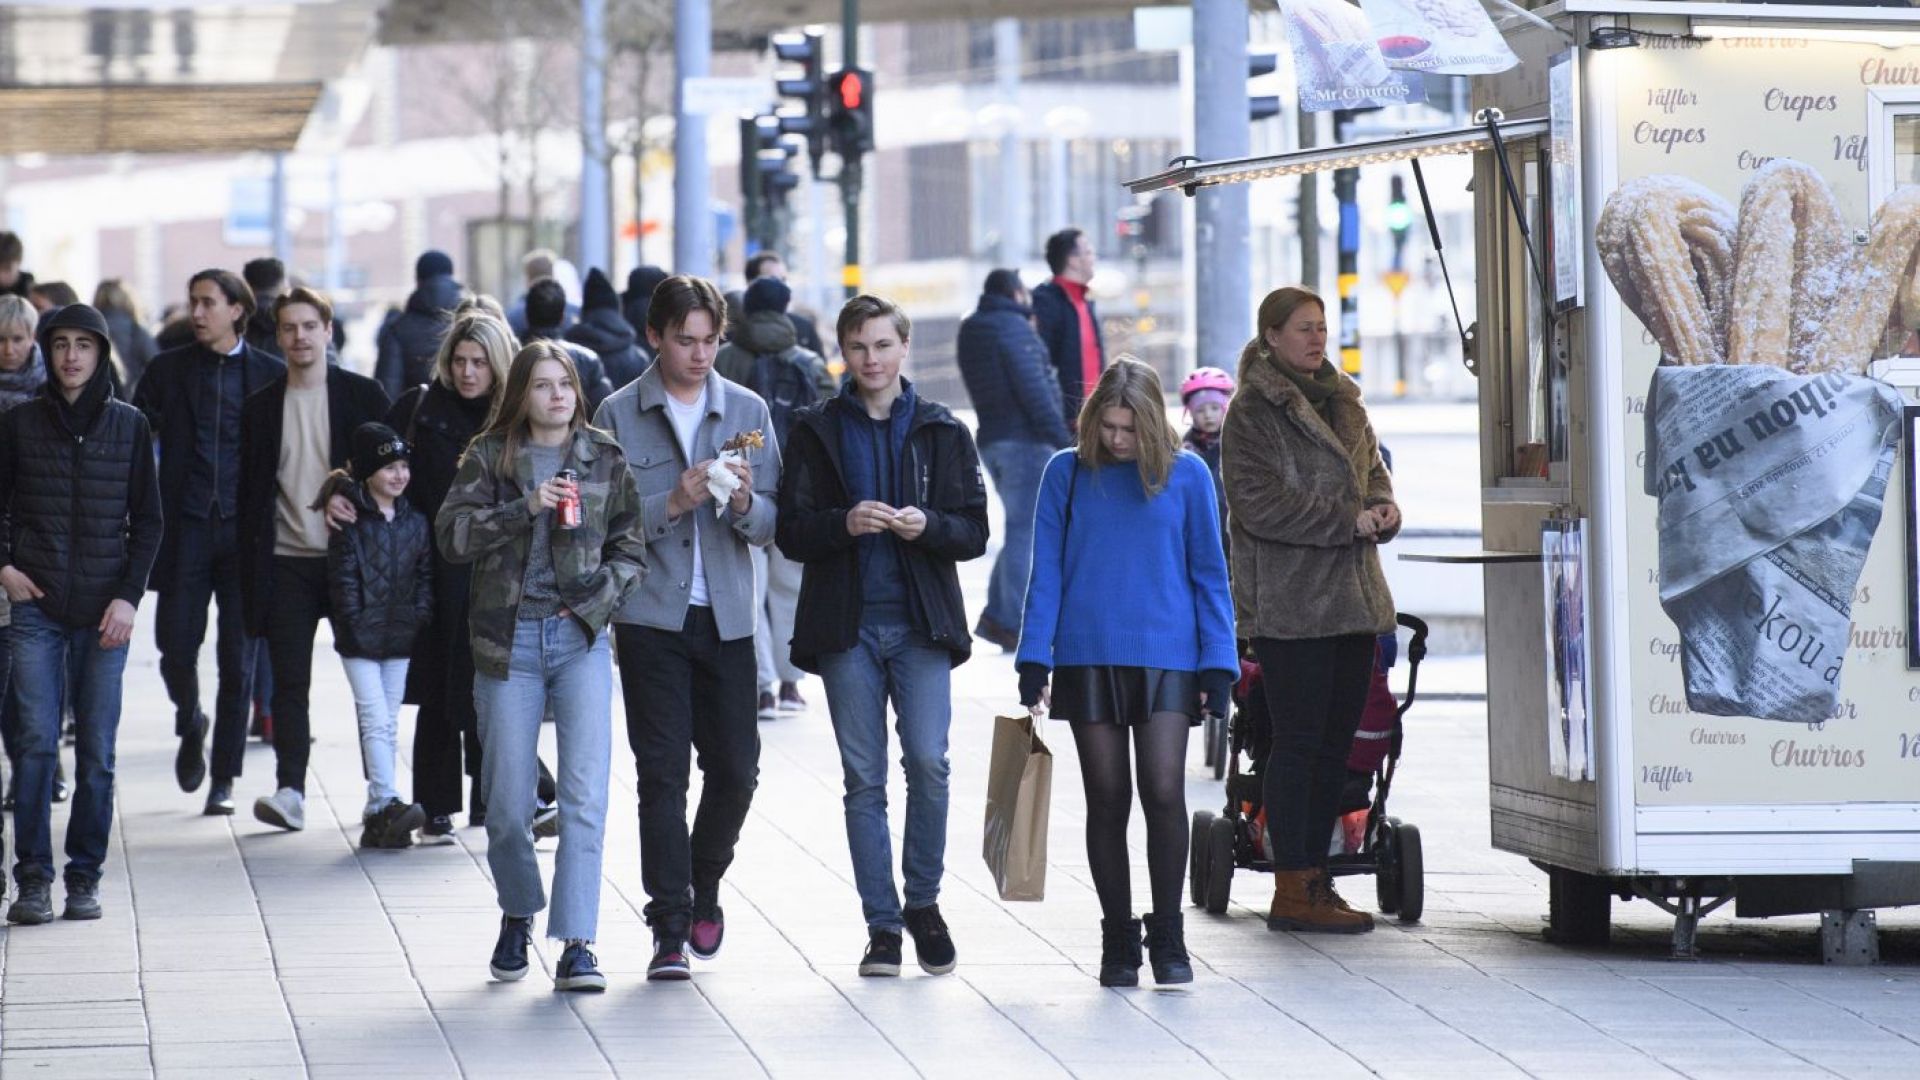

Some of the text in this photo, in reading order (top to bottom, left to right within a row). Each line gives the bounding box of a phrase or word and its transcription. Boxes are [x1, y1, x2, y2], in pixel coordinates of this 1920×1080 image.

[1764, 87, 1838, 121] Crepes
[1633, 120, 1706, 154] Crepes
[1689, 727, 1747, 746] Churros
[1769, 738, 1866, 768] Churros
[1641, 765, 1694, 792] Våfflor
